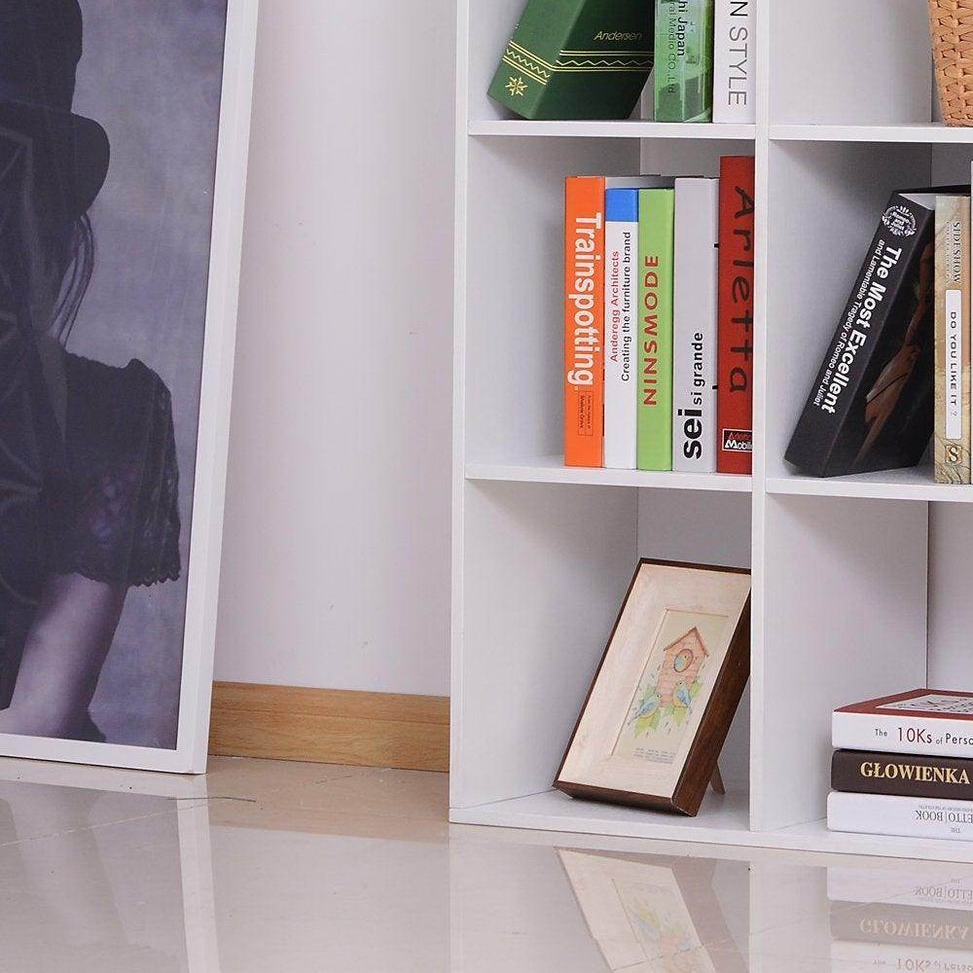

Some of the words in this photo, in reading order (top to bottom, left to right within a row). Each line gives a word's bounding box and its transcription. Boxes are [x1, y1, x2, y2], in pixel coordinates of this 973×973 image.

[593, 30, 642, 41] Andersen
[676, 17, 688, 56] Japan
[727, 27, 748, 106] STYLE
[622, 231, 631, 263] brand
[875, 239, 885, 256] and
[877, 247, 902, 278] The
[953, 221, 962, 283] SIDESHOW
[610, 251, 619, 307] Architects
[622, 266, 630, 313] furniture
[856, 255, 880, 300] Lamentable
[567, 212, 601, 386] Trainspotting
[856, 281, 886, 328] Most
[622, 315, 630, 332] the
[643, 255, 659, 406] NINSMODE
[843, 301, 862, 332] Tragedy
[950, 311, 958, 329] DO
[610, 309, 620, 362] Anderegg
[841, 332, 847, 342] of
[950, 334, 958, 358] YOU
[621, 336, 631, 382] Creating
[691, 332, 705, 386] grande
[828, 341, 845, 369] Romeo
[821, 329, 867, 414] Excellent
[822, 369, 832, 385] and
[950, 363, 958, 389] LIKE
[693, 388, 702, 405] si
[813, 384, 826, 406] Juliet
[950, 394, 958, 407] IT
[678, 408, 702, 459] sei
[875, 728, 888, 737] The
[898, 727, 933, 744] 10Ks
[915, 810, 943, 823] BOOK
